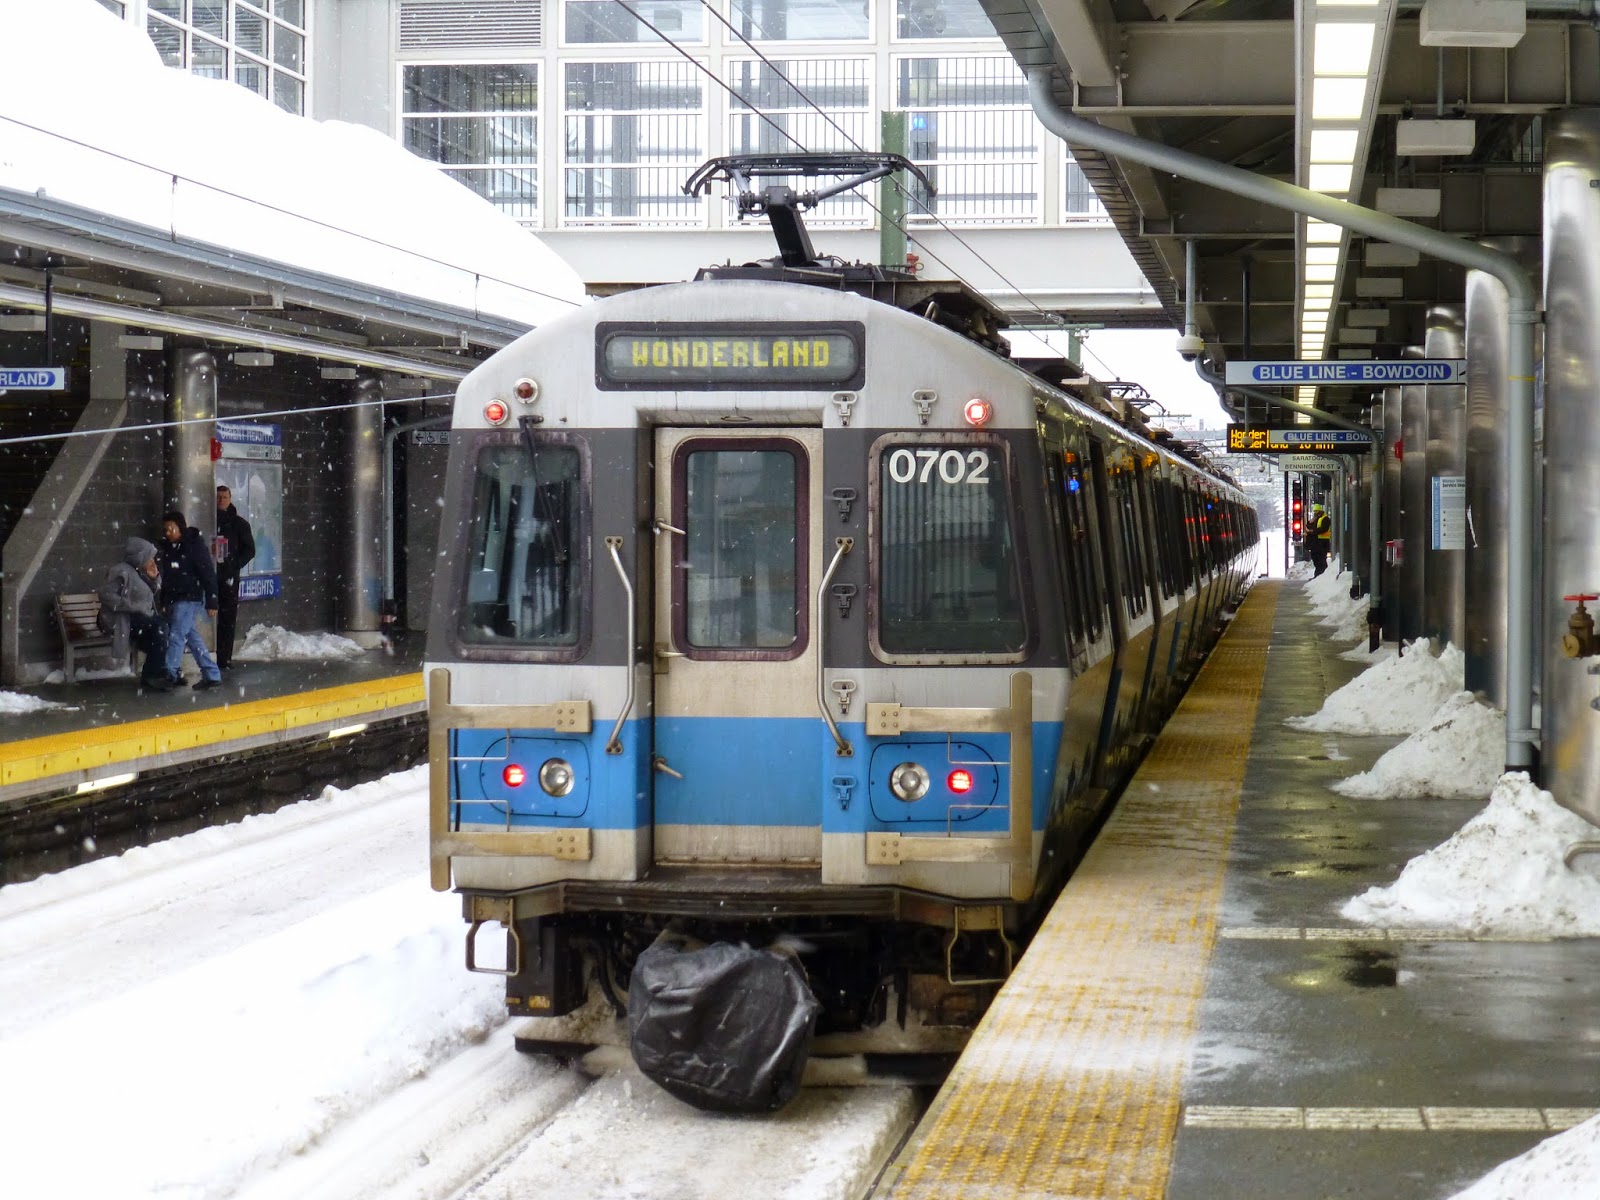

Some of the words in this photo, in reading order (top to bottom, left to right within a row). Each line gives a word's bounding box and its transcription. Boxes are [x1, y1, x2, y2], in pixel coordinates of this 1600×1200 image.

[631, 340, 830, 368] WONDERLAND
[1259, 365, 1304, 380] BLUE
[1308, 365, 1347, 379] LINE
[1362, 364, 1445, 379] BOWDOIN
[1287, 432, 1313, 441] BLUE
[1315, 432, 1337, 441] LINE
[889, 449, 990, 484] 0702
[246, 578, 274, 597] HEIGHTS
